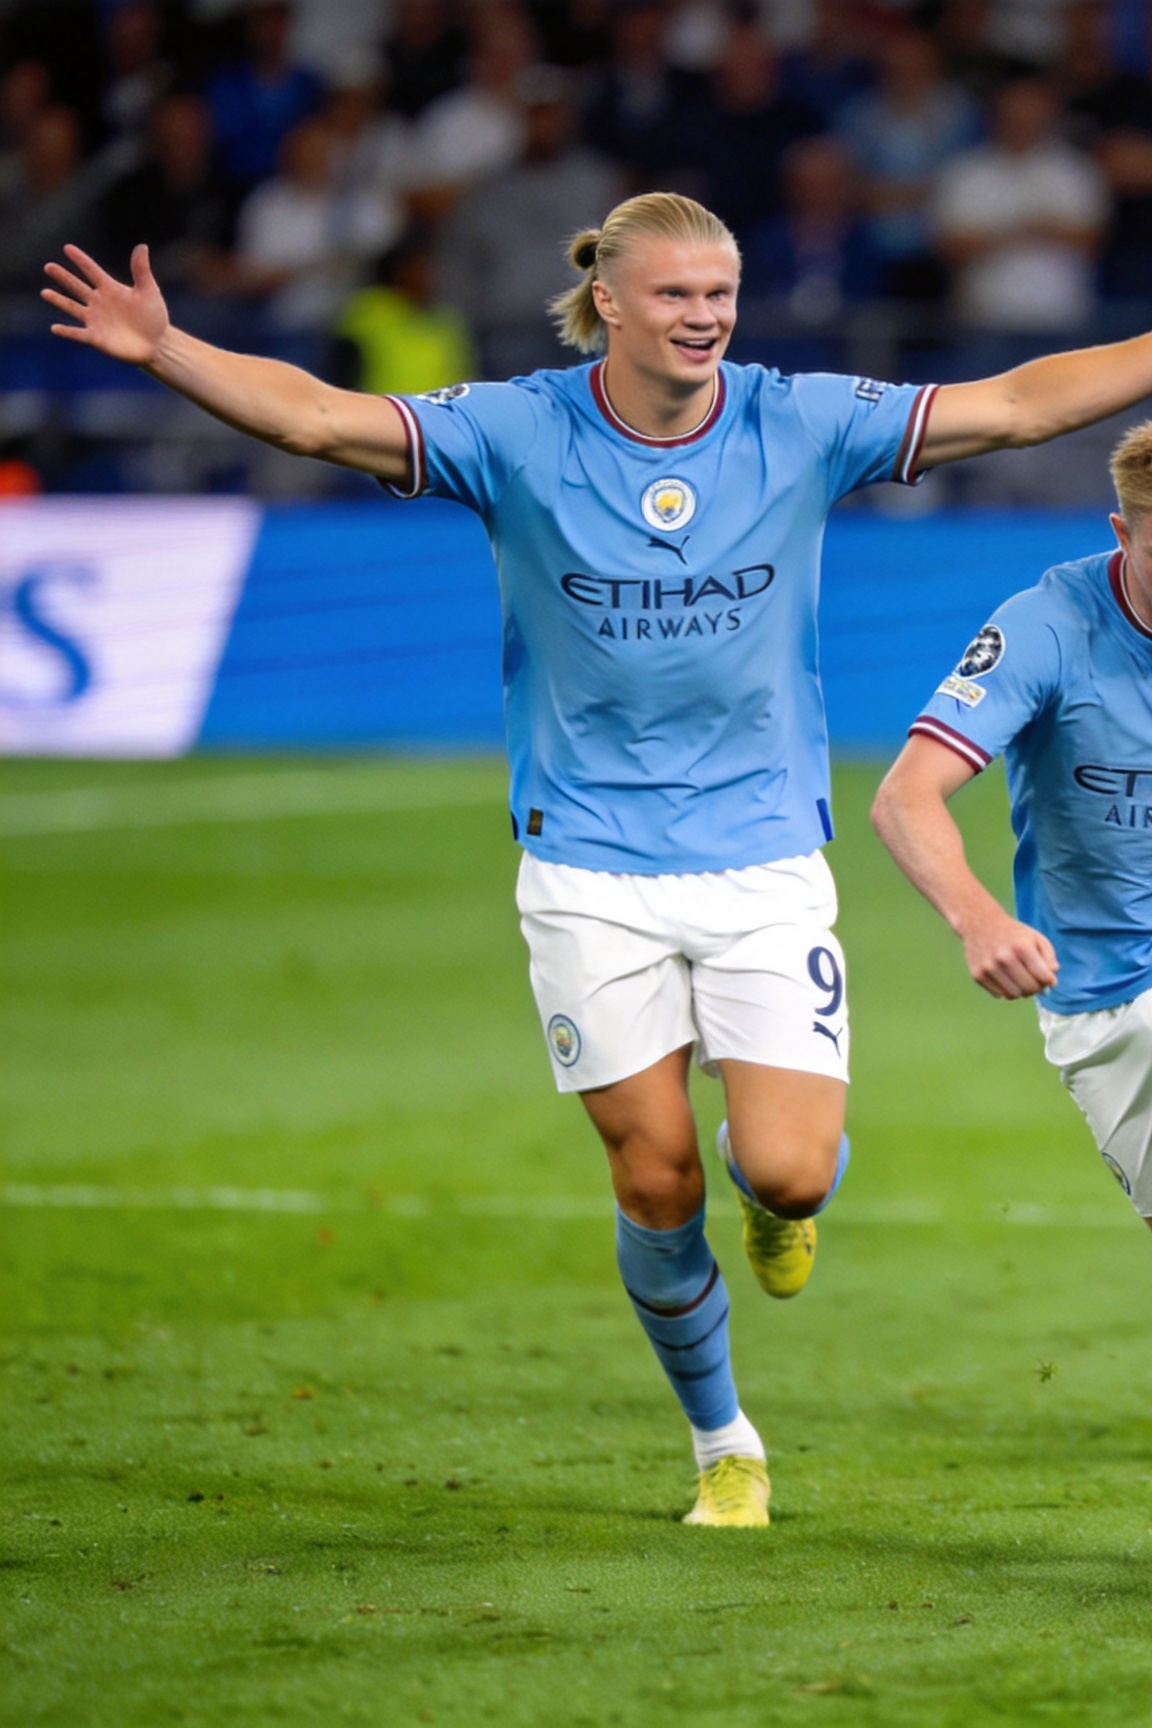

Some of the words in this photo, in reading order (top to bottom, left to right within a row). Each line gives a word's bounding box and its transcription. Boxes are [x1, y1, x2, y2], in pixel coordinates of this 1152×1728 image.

[561, 563, 775, 610] ETIHAD
[598, 607, 742, 641] AIRWAYS
[806, 946, 843, 1016] 9
